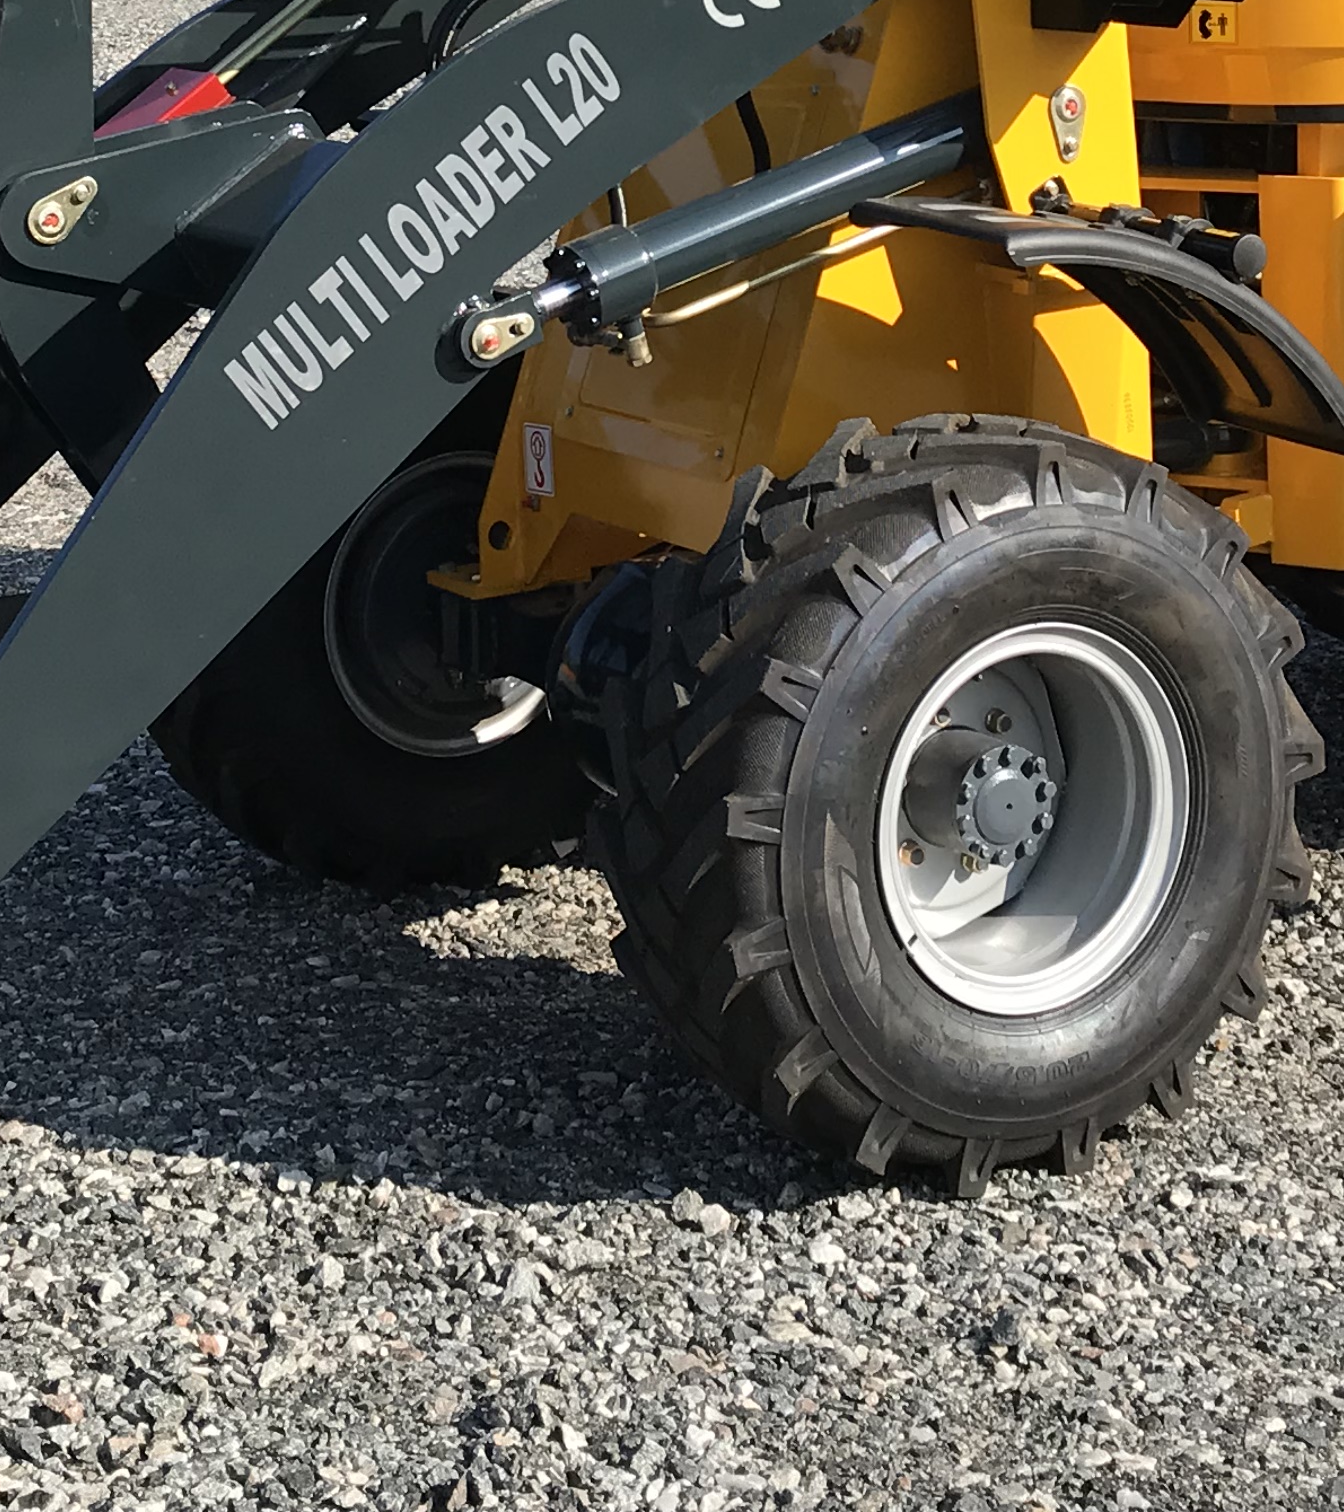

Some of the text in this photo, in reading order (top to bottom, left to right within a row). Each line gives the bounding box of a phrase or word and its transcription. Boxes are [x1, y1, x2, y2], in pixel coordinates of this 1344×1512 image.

[223, 33, 621, 430] MULTI LOADER L20
